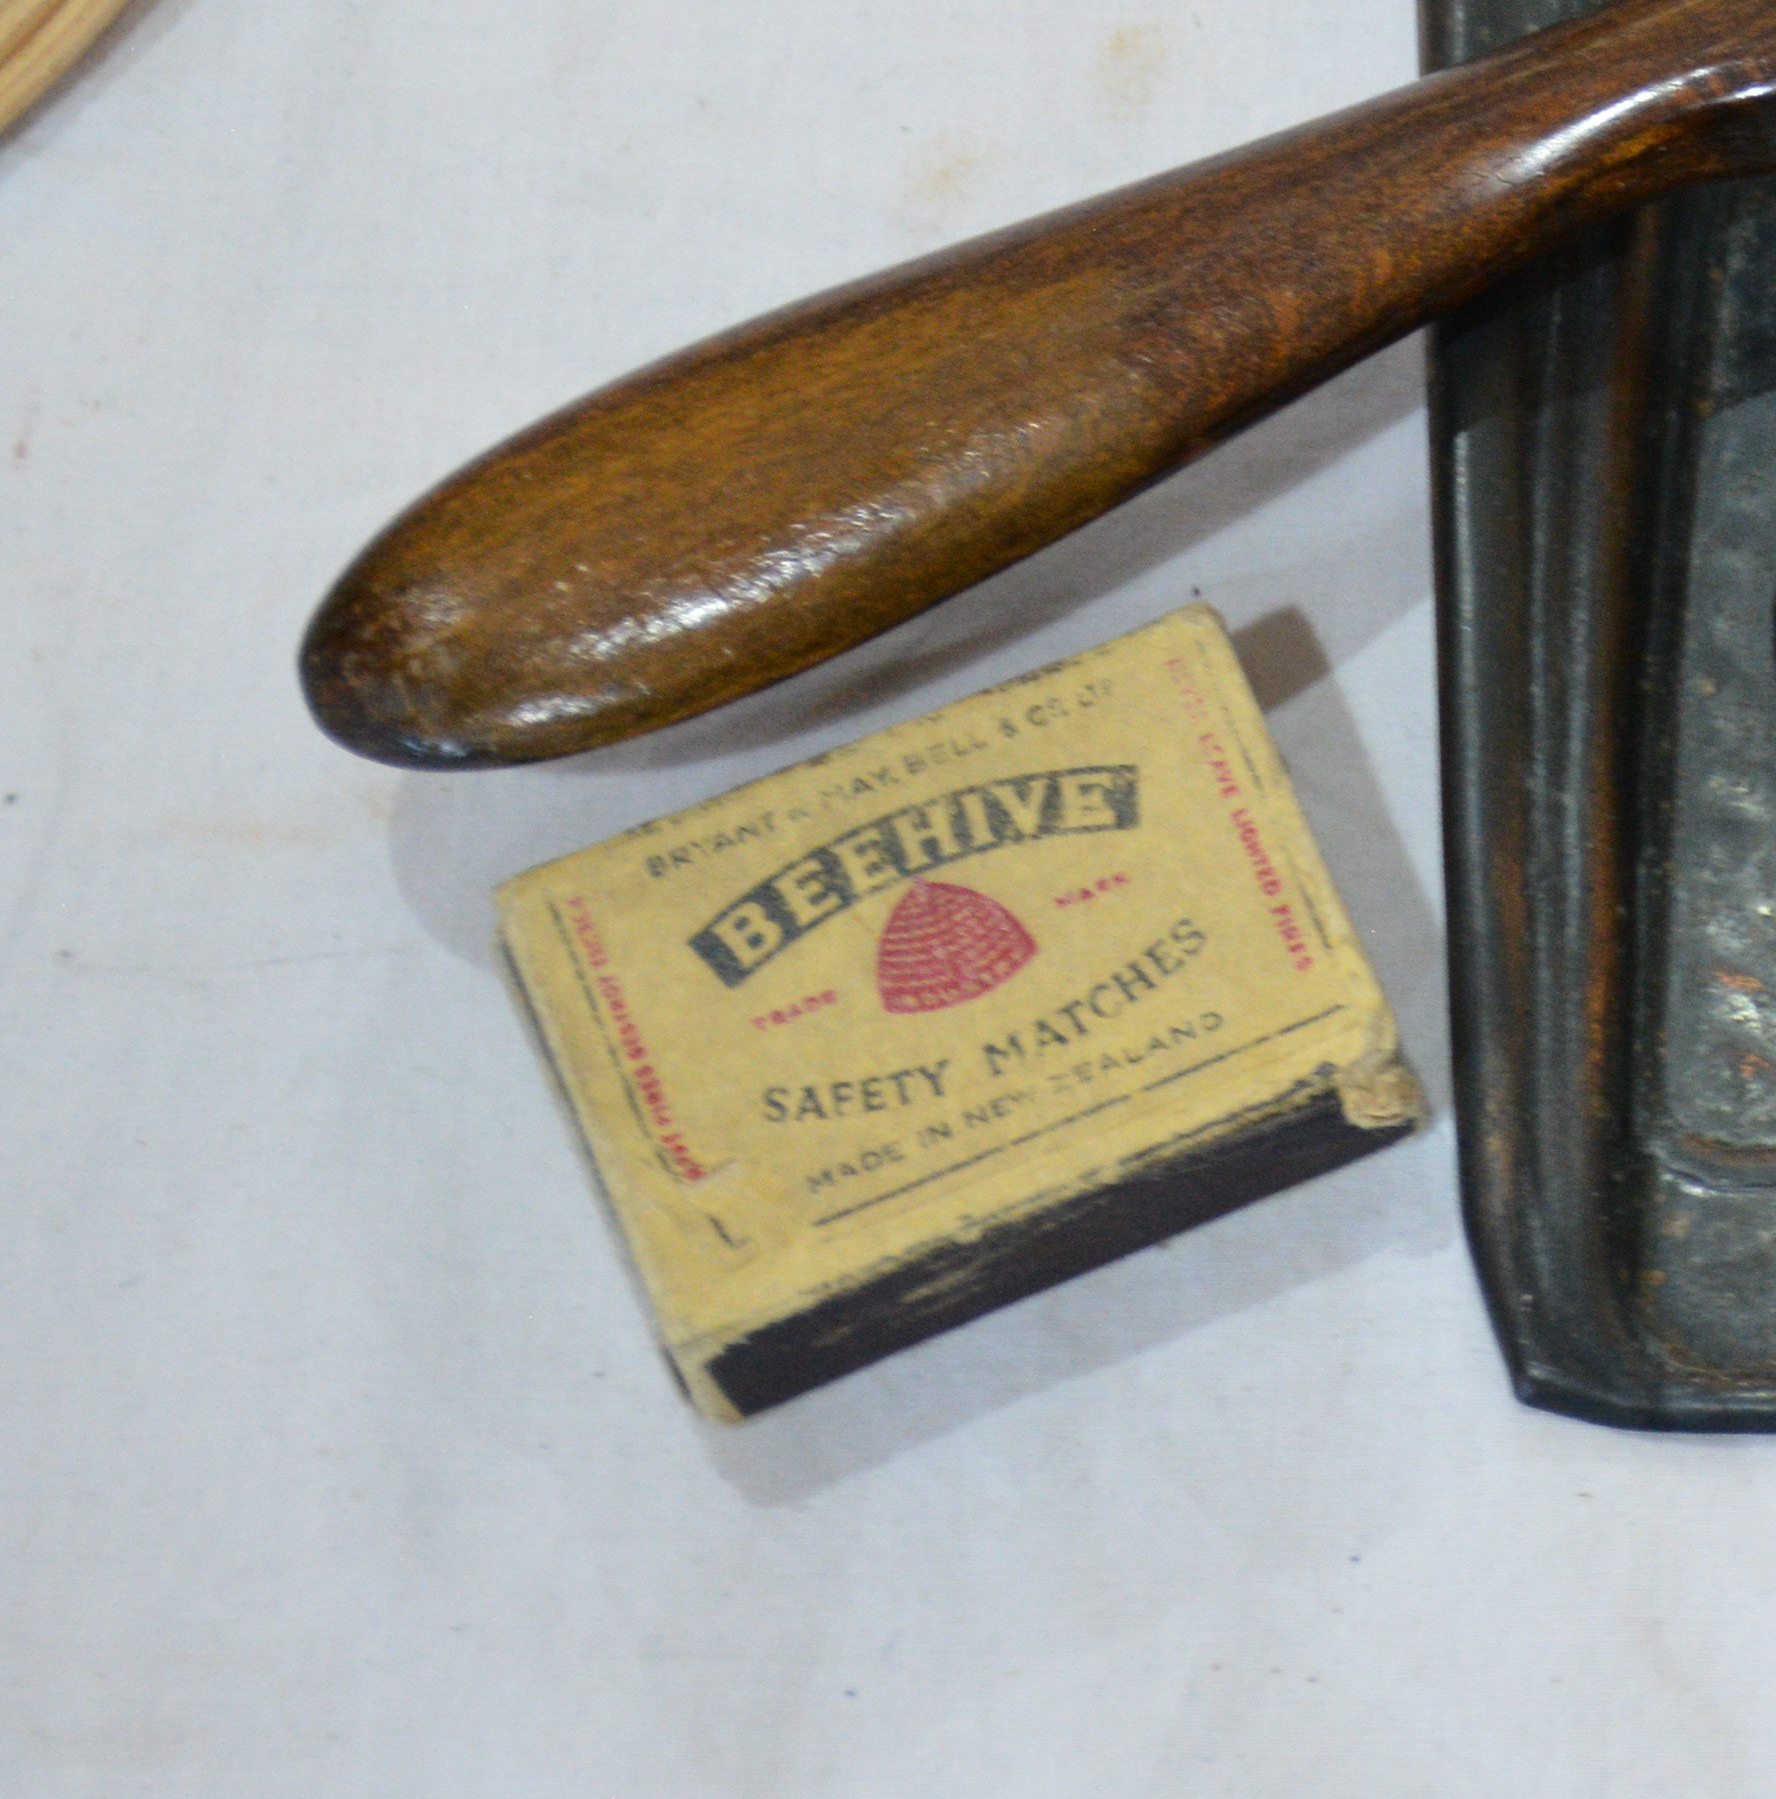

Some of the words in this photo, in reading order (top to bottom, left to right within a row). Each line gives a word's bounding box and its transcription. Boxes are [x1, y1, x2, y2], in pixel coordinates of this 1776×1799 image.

[713, 772, 1118, 968] BEEHIVE
[752, 987, 838, 1030] TRADE
[1053, 872, 1131, 908] MARK
[762, 1059, 949, 1123] SAFETY
[981, 917, 1206, 1077] MATCHES
[806, 1143, 904, 1194] MADE
[918, 1121, 955, 1149] IN
[961, 1089, 1032, 1129] NEW
[1048, 1010, 1224, 1087] ZEALAND
